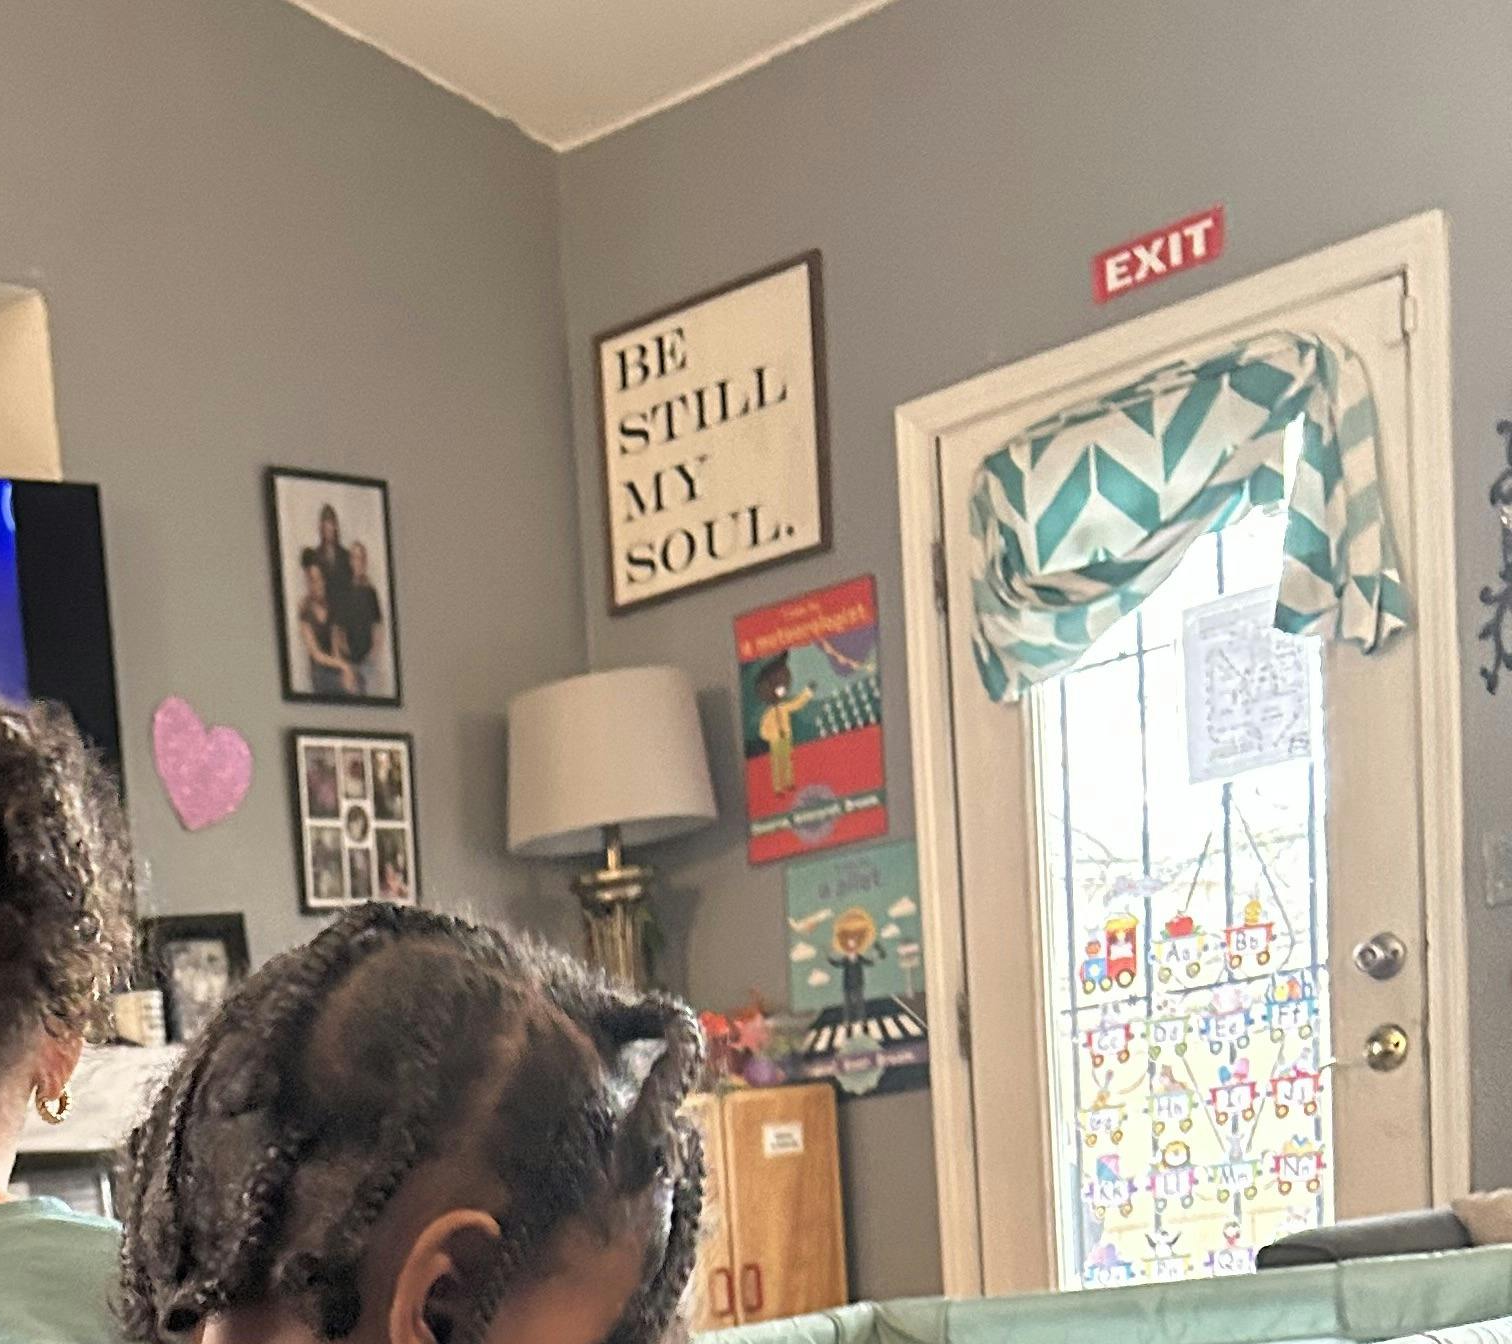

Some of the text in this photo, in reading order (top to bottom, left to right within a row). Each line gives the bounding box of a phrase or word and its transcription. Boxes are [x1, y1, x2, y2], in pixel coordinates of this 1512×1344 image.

[1104, 215, 1216, 293] EXIT
[613, 326, 688, 392] BE
[619, 365, 789, 458] STILL
[623, 453, 708, 525] MY
[625, 505, 796, 586] SOUL.
